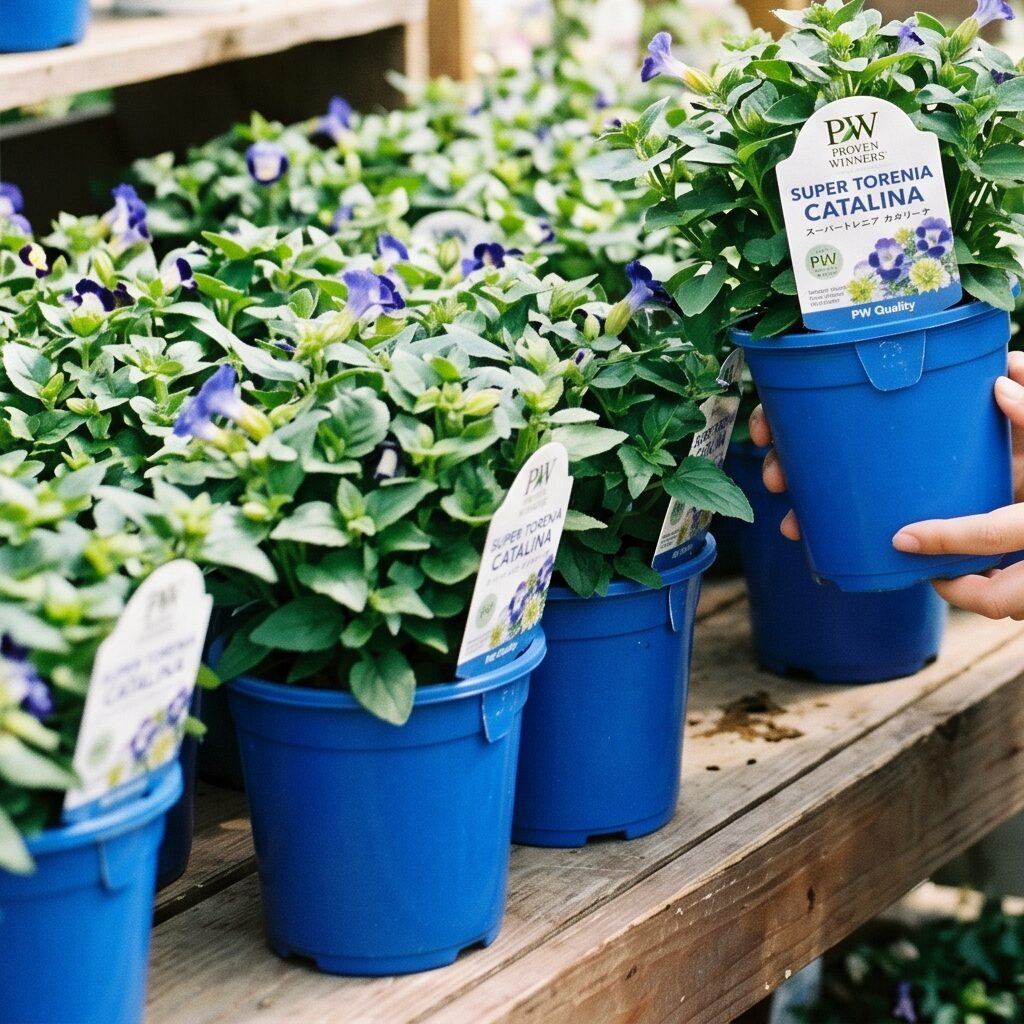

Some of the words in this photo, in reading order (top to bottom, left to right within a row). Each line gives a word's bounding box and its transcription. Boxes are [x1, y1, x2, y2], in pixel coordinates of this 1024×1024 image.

[824, 112, 878, 146] PW
[828, 151, 886, 169] WINNERS
[831, 141, 879, 157] PROVEN
[790, 180, 848, 202] SUPER
[852, 165, 934, 191] TORENIA
[804, 185, 925, 222] CATALINA
[810, 252, 836, 268] PW
[851, 307, 871, 320] PW
[873, 301, 916, 316] Quality
[524, 457, 558, 495] PW
[491, 529, 552, 571] CATALINA
